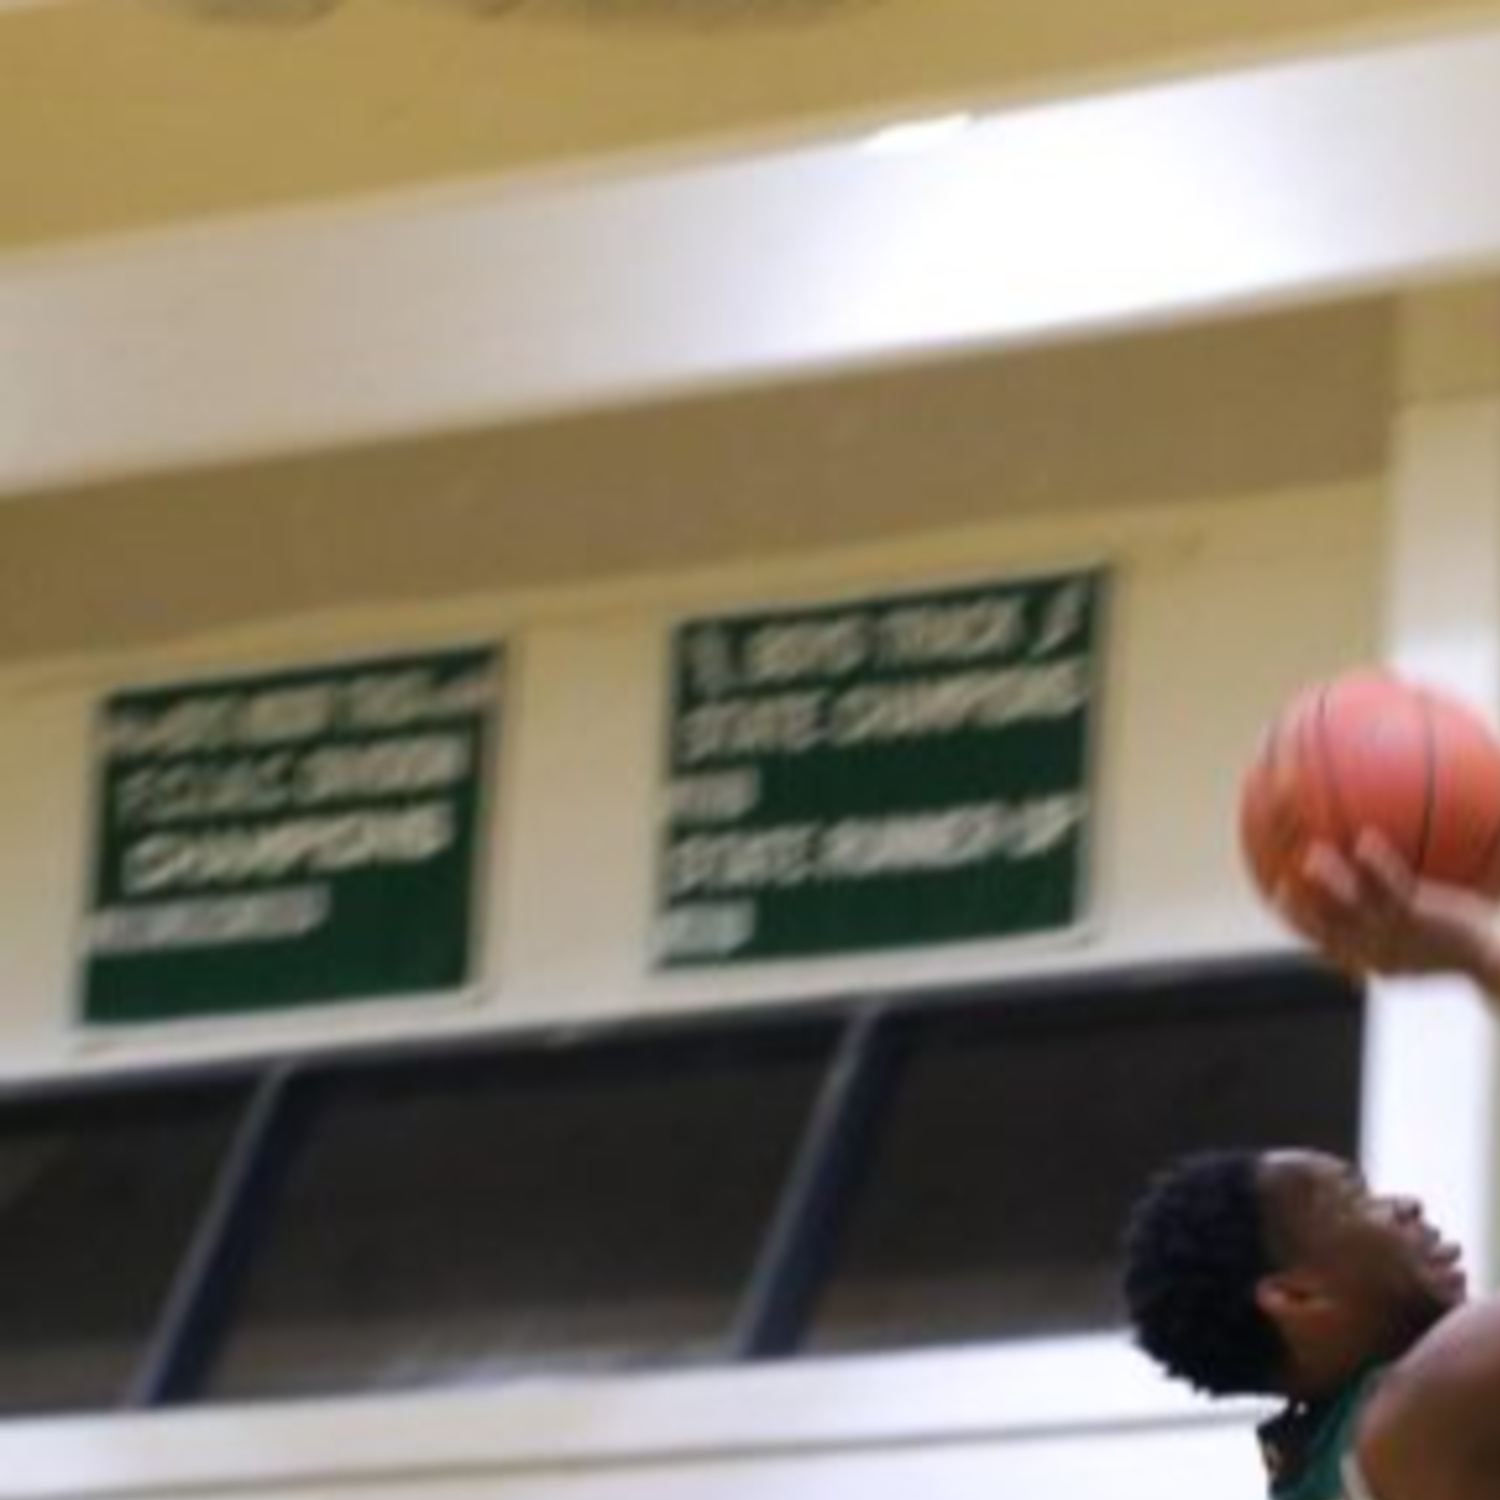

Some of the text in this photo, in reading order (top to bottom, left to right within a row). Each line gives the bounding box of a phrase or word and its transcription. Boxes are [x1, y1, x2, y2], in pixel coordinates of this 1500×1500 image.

[677, 656, 1092, 764] STATE CHAMPIONS
[122, 802, 457, 894] CHAMPIONS
[668, 822, 822, 896] STATE
